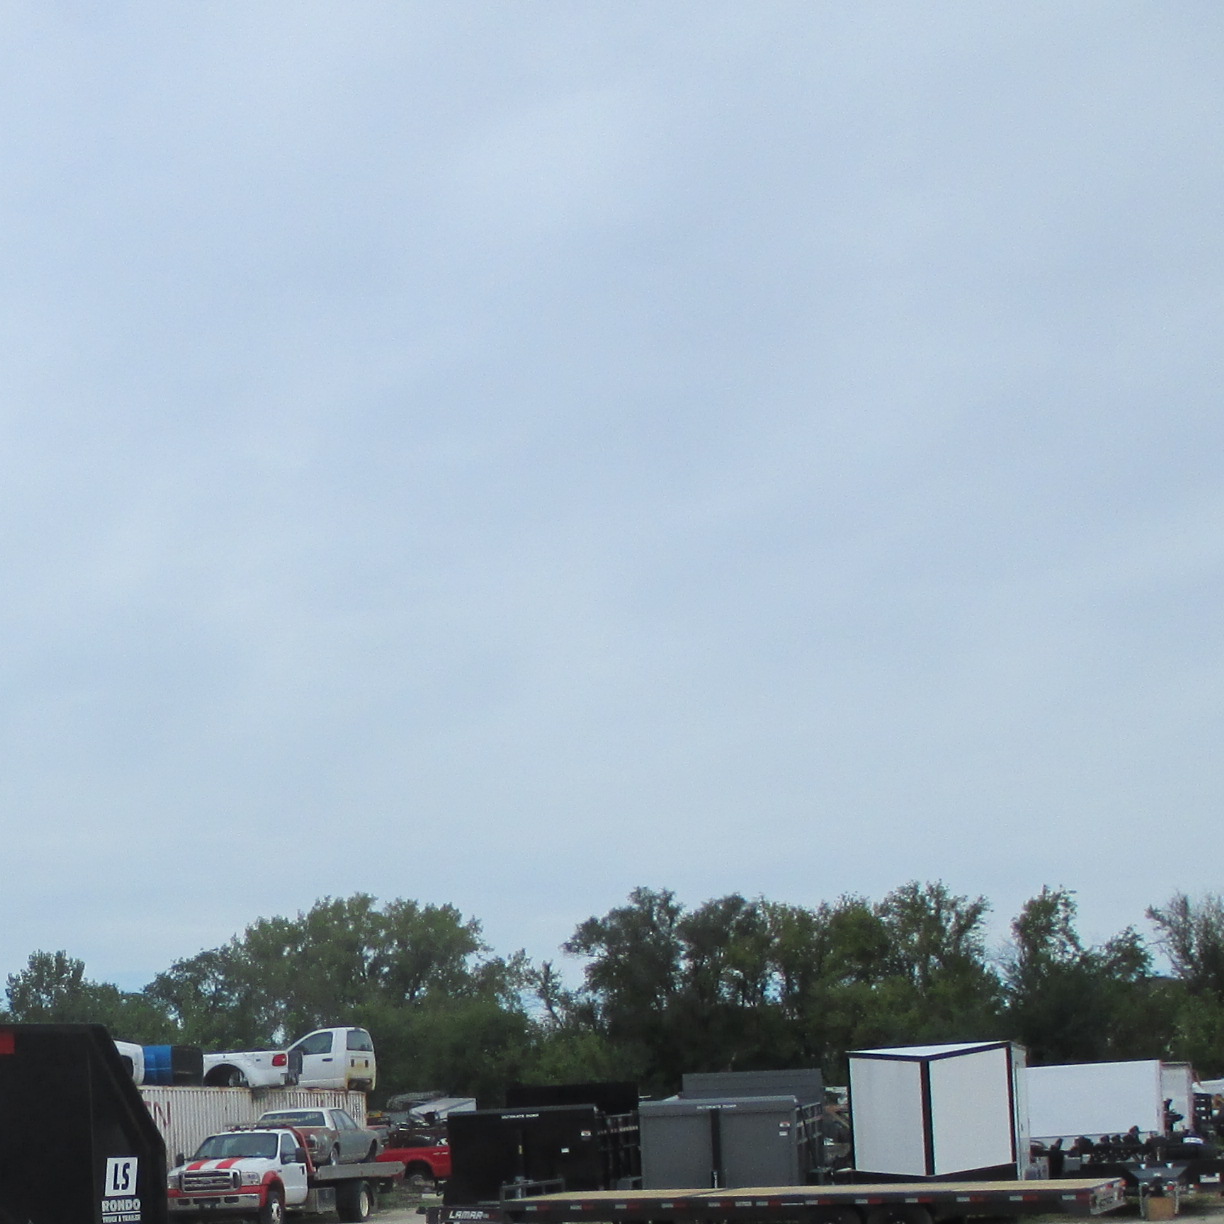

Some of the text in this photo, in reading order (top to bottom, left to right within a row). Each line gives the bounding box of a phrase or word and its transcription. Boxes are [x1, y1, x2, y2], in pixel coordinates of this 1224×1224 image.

[113, 1162, 130, 1190] LS
[102, 1199, 141, 1212] RONDO
[448, 1210, 483, 1219] LAMAR
